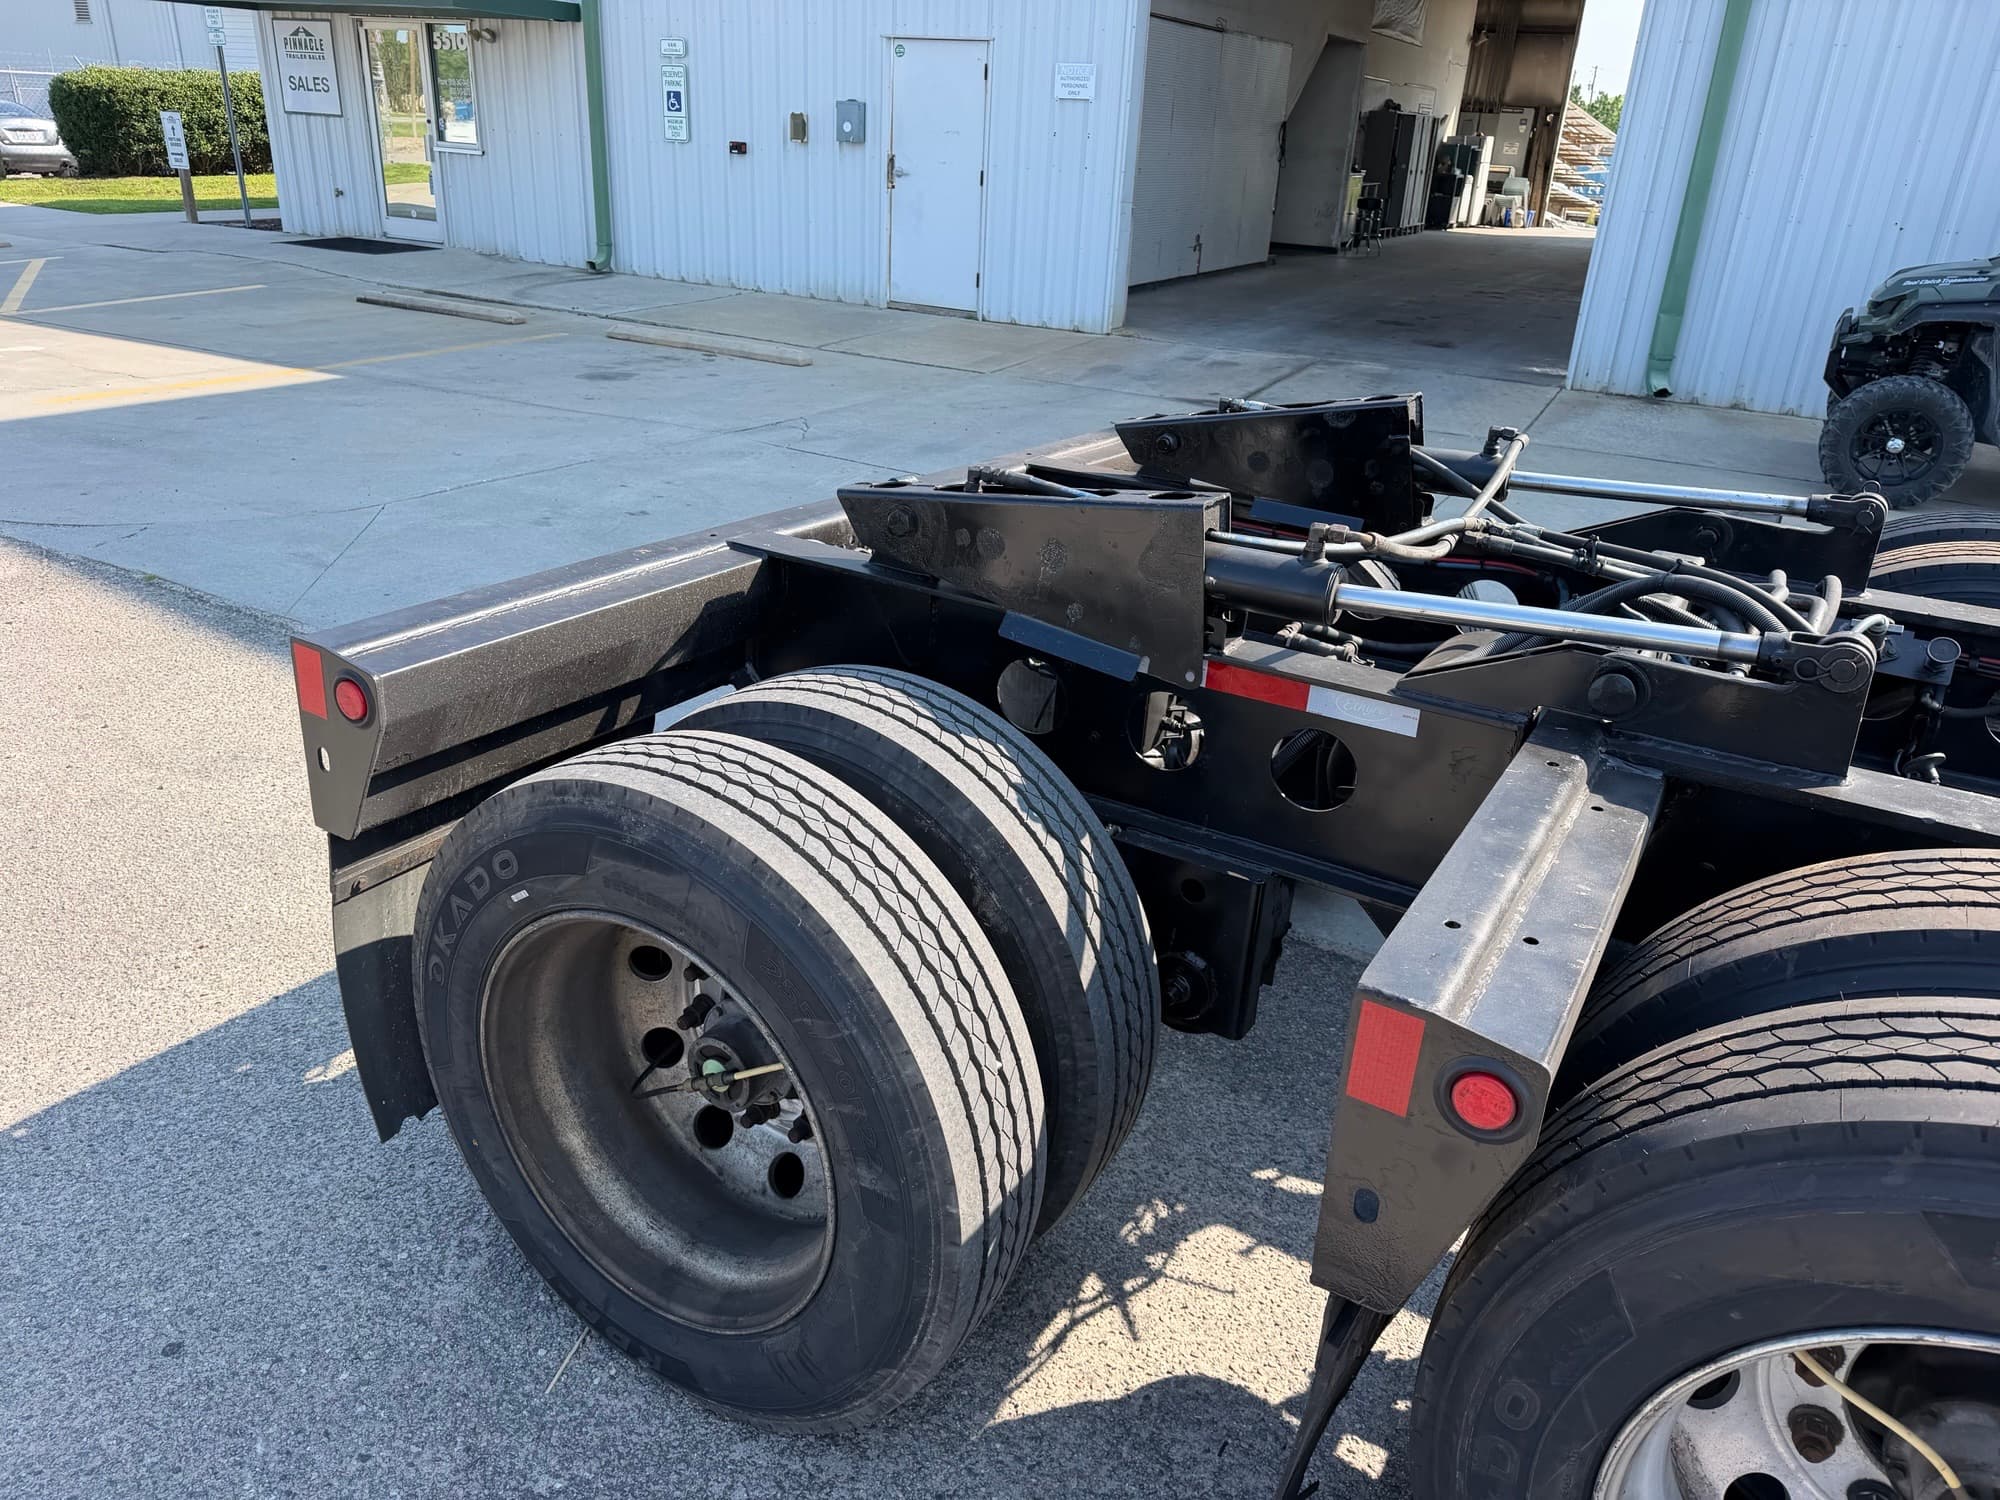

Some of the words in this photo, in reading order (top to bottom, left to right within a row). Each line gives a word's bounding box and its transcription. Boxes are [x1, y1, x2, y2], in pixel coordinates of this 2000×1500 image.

[283, 37, 325, 51] PINNACLE
[433, 32, 468, 50] 5510
[288, 75, 330, 93] SALES
